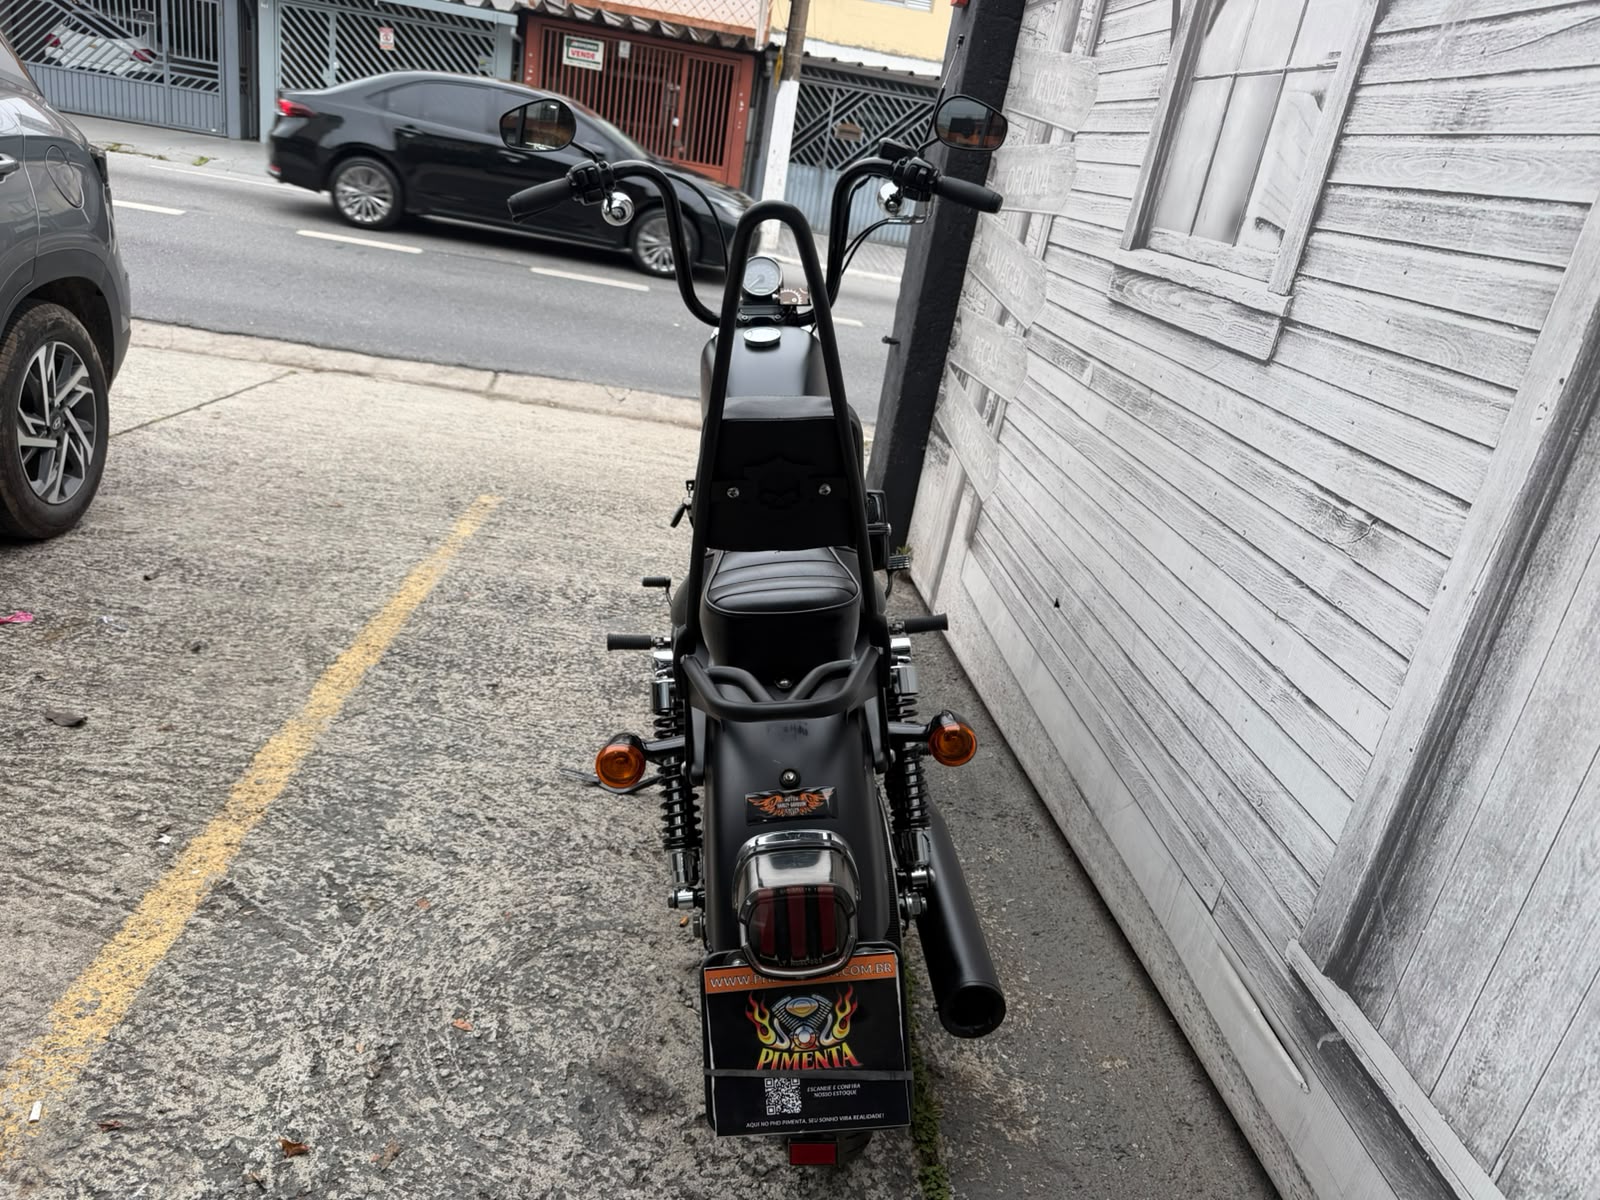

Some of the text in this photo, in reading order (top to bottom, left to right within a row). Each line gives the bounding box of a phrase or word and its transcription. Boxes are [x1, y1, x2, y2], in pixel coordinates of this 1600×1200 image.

[1031, 66, 1069, 106] VENDA
[1005, 164, 1051, 195] OFICINA
[985, 242, 1030, 297] LAVAGEM
[756, 1042, 864, 1070] PIMENTA
[819, 1115, 839, 1123] SONHO
[853, 1112, 885, 1120] REALIDADE!
